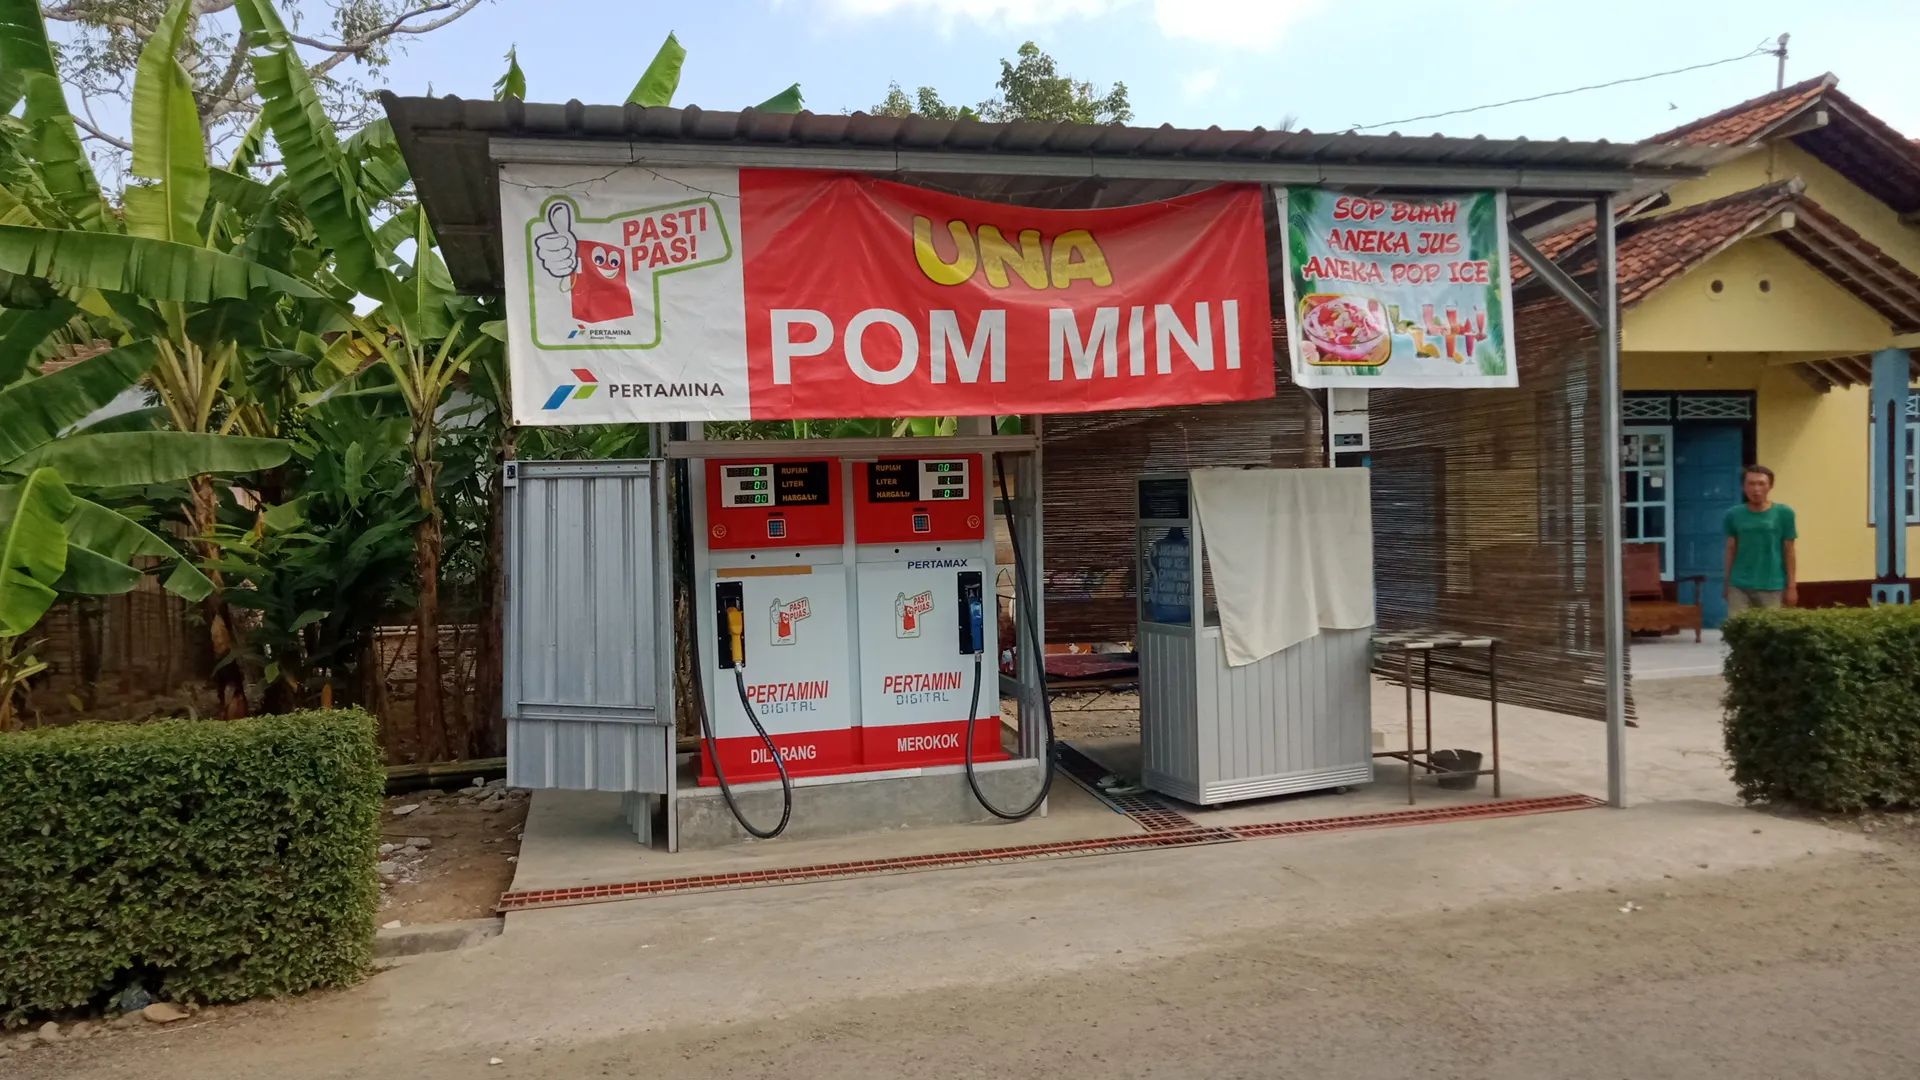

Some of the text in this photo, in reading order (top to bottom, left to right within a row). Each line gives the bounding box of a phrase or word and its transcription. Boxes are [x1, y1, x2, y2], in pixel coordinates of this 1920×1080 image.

[1333, 197, 1458, 223] SOP BUAH
[622, 207, 707, 246] PASTI
[912, 214, 1114, 290] UNA
[1326, 228, 1461, 254] ANEKA JUS
[632, 236, 698, 271] PAS!
[1303, 256, 1490, 284] ANEKA POP ICE
[769, 300, 1242, 386] POM MINI
[609, 382, 724, 398] PERTAMINA
[781, 467, 808, 475] RUPIAH
[875, 464, 902, 472] RUPIAH
[781, 480, 804, 488] LITER
[907, 558, 968, 570] PERTAMAX
[789, 599, 807, 612] PASTI
[913, 593, 930, 605] PASTI
[746, 680, 829, 704] PERTAMINI
[883, 671, 962, 694] PERTAMINI
[761, 701, 817, 715] DIGITAL
[896, 691, 949, 705] DIGITAL
[751, 733, 960, 764] DILRANG MEROKOK
